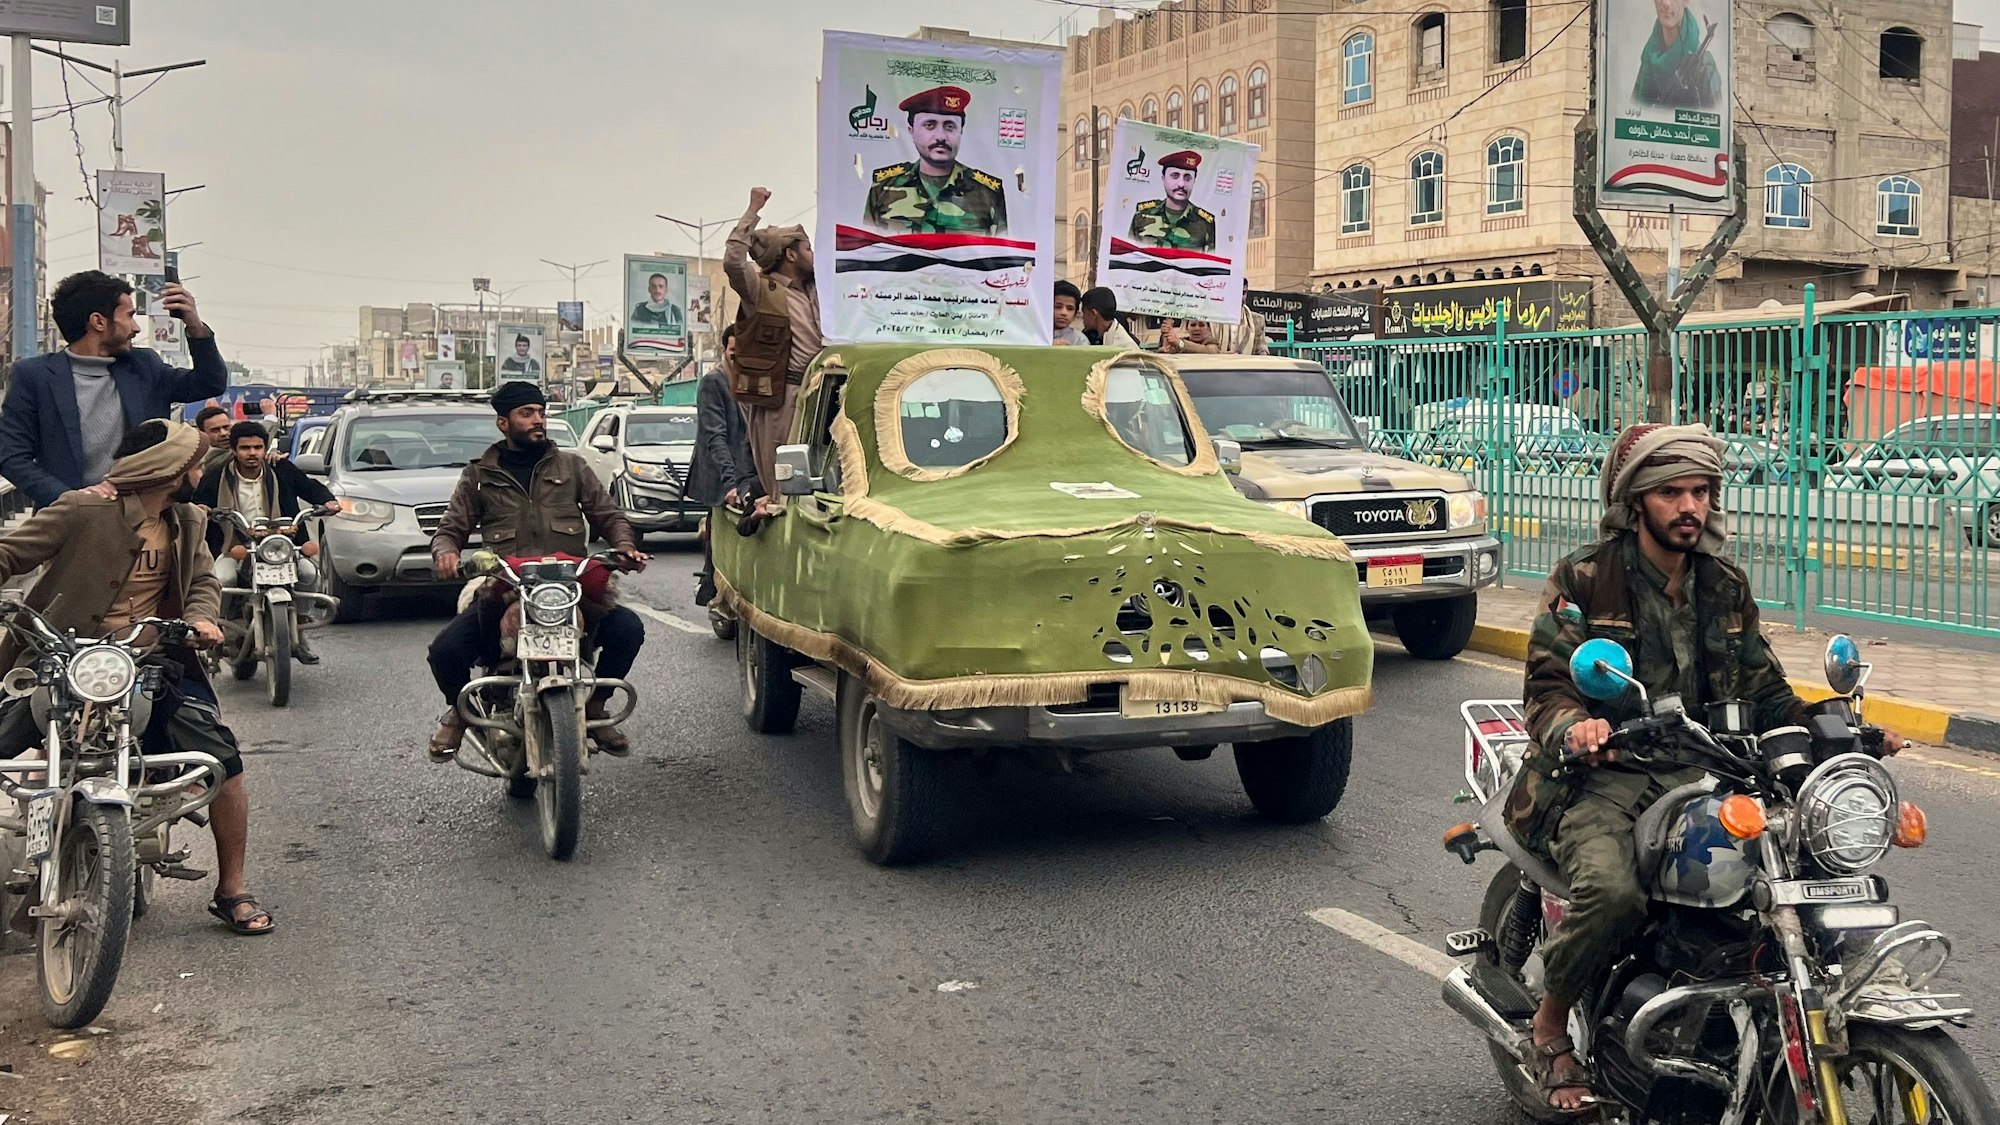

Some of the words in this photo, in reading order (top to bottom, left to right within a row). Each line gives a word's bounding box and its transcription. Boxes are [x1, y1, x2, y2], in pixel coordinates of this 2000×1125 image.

[1678, 112, 1700, 124] المجاهد
[1701, 114, 1718, 126] الشهيد
[1673, 125, 1690, 139] أحمد
[1690, 133, 1710, 143] حسين
[904, 290, 920, 300] أحمد
[922, 293, 941, 303] محمد
[1252, 296, 1282, 309] الملكة
[1283, 299, 1302, 311] ديور
[1516, 286, 1550, 332] روما
[1310, 306, 1332, 321] للعبايات
[1332, 304, 1351, 317] الملكة
[1351, 306, 1364, 318] ديور
[1411, 300, 1464, 333] والجلديات
[1353, 508, 1405, 524] TOYOTA
[1383, 577, 1408, 586] 25191
[1155, 700, 1199, 714] 13138
[1809, 884, 1860, 897] BMSPORTY
